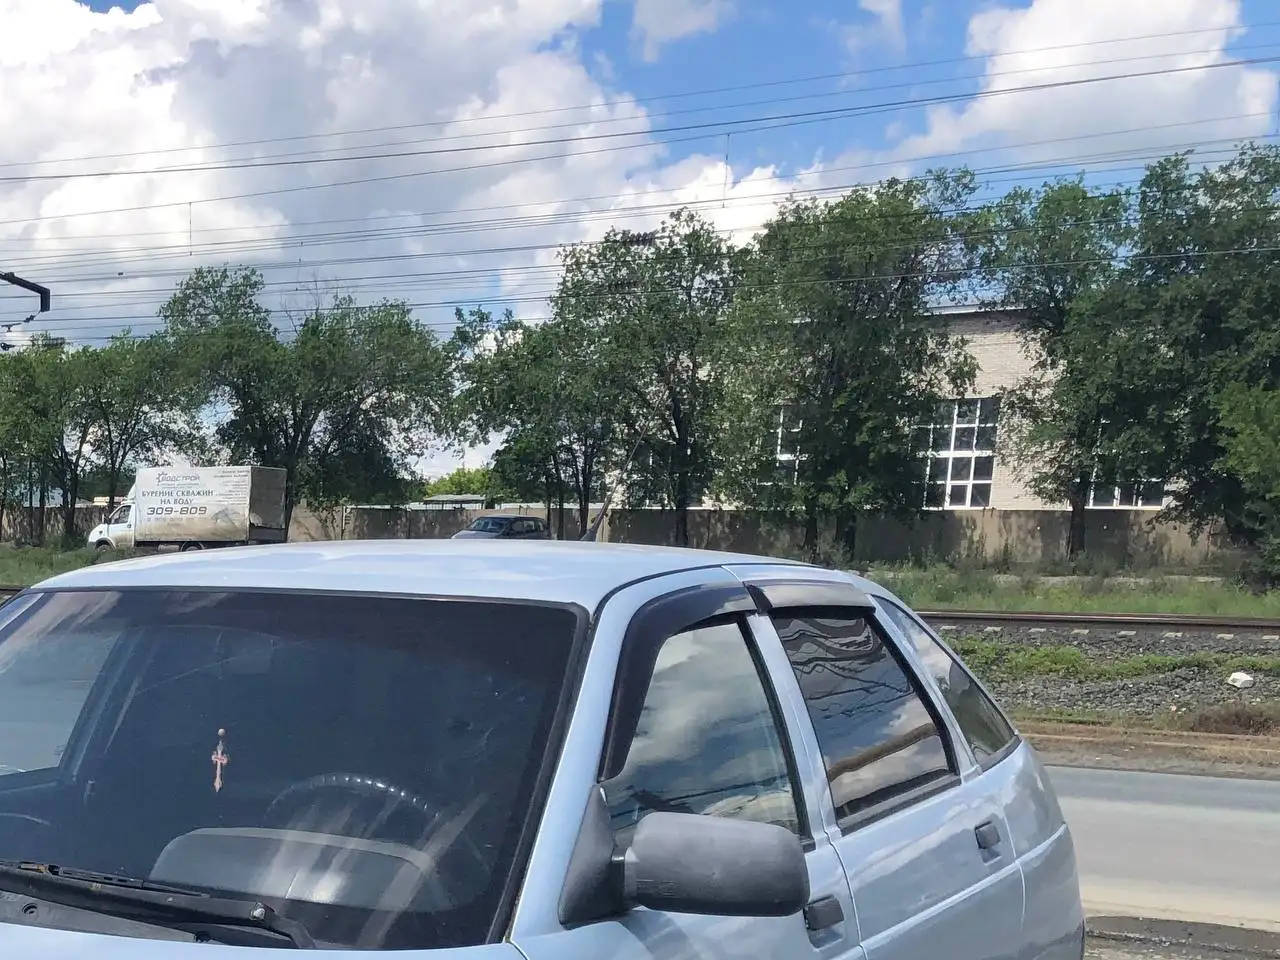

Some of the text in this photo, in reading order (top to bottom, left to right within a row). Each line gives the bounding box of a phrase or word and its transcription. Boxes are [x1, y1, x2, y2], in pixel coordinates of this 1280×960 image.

[142, 489, 214, 498] БУРЕНИЕ СКВАЖИН
[147, 506, 207, 515] 309-809
